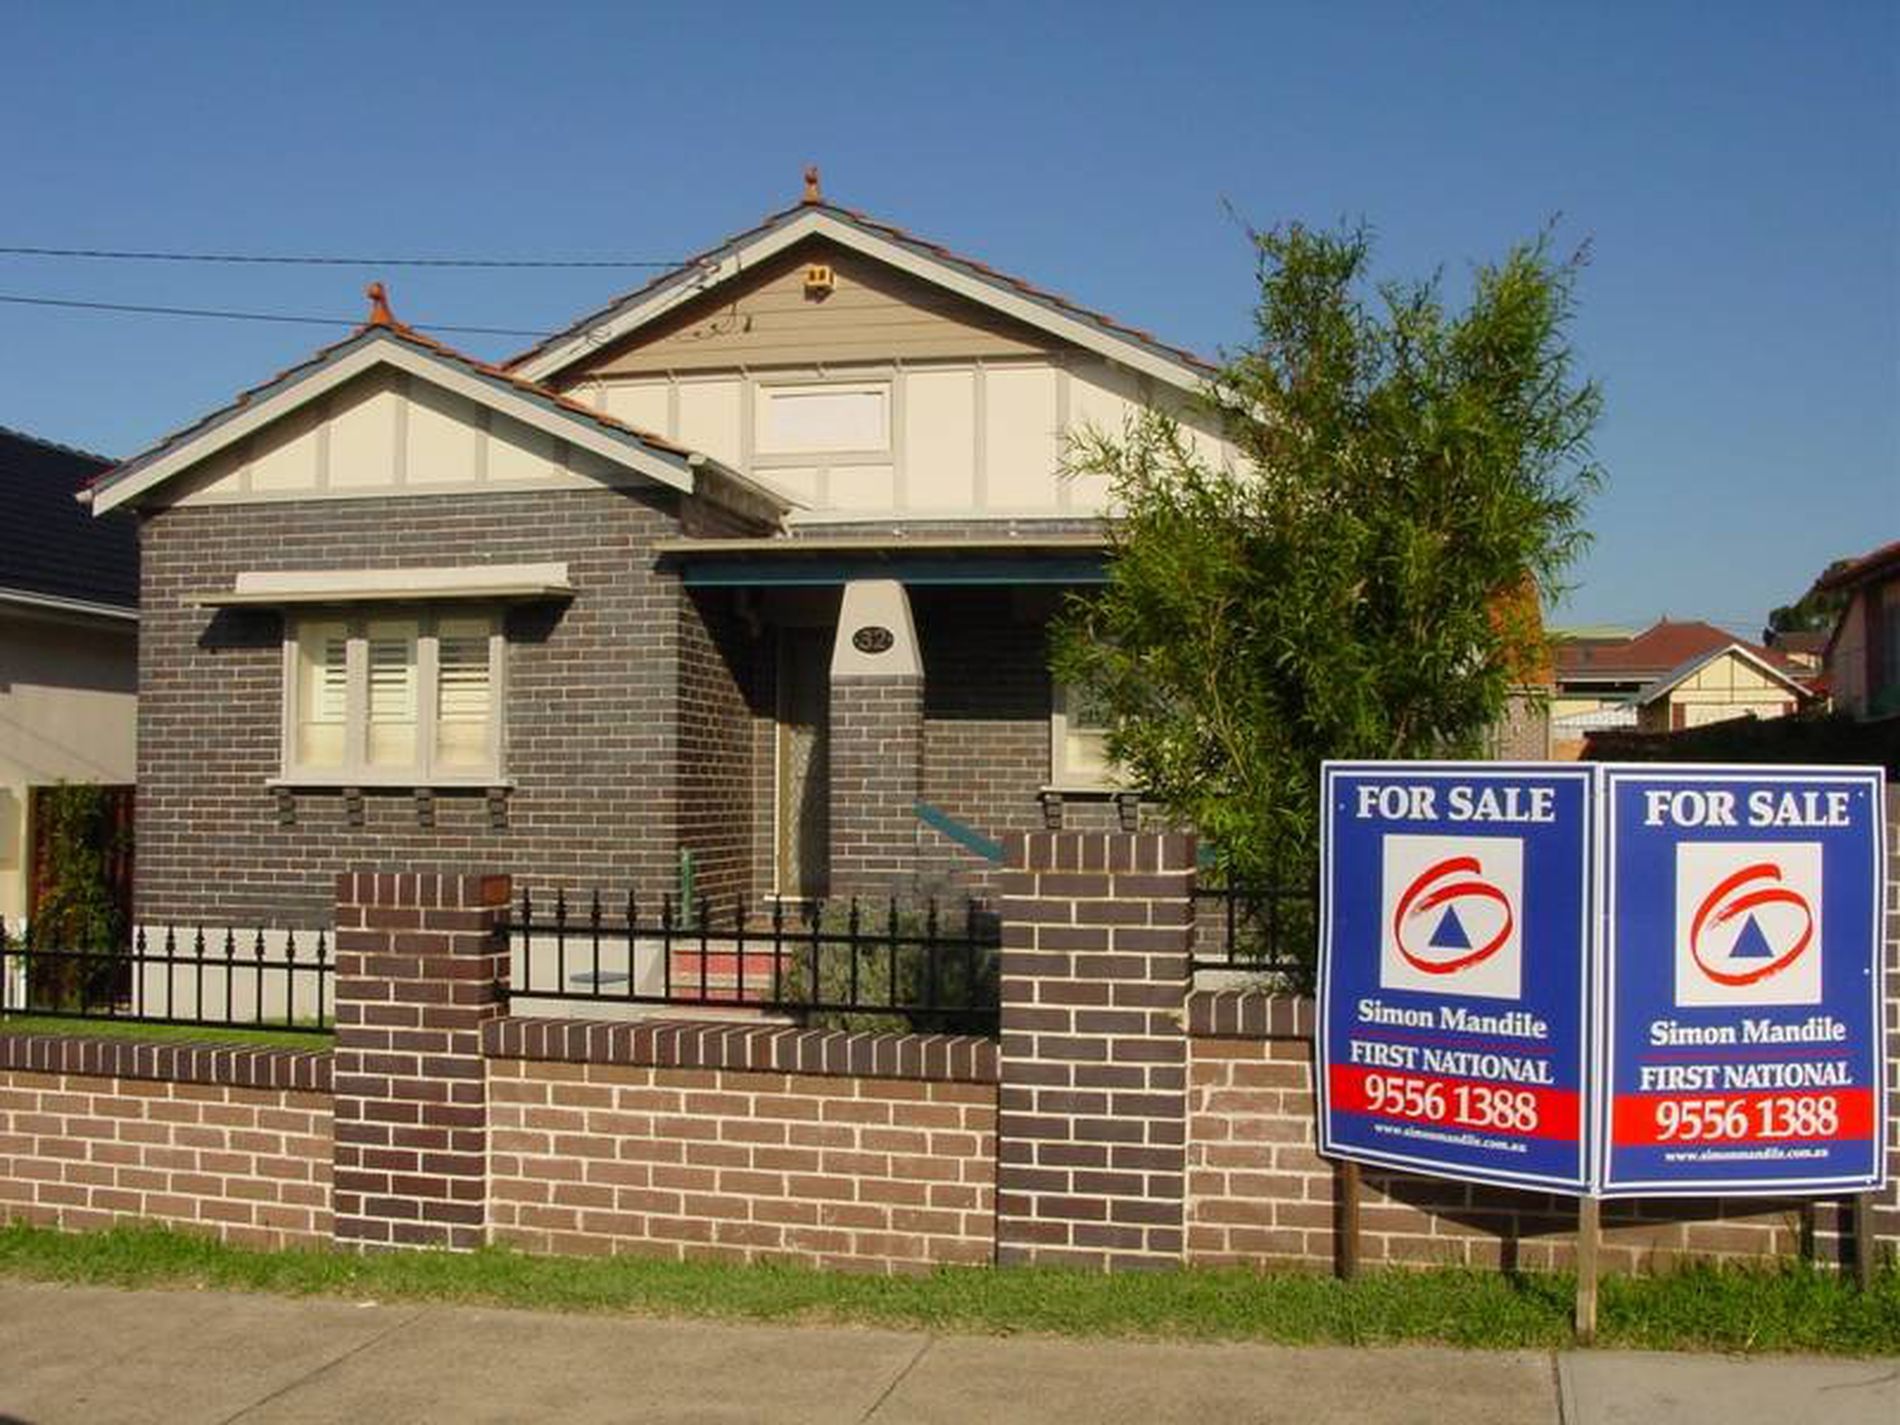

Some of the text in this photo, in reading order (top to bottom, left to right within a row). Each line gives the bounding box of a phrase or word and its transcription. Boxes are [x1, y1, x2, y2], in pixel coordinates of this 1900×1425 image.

[859, 630, 886, 649] 32
[1356, 785, 1555, 822] FOR SALE
[1644, 790, 1850, 827] FOR SALE
[1358, 998, 1548, 1039] Simon Mandile
[1650, 1016, 1847, 1046] Simon Mandile
[1350, 1040, 1554, 1084] FIRST NATIONAL
[1640, 1061, 1852, 1091] FIRST NATIONAL
[1364, 1074, 1539, 1132] 9556 1388
[1655, 1096, 1839, 1140] 9556 1388
